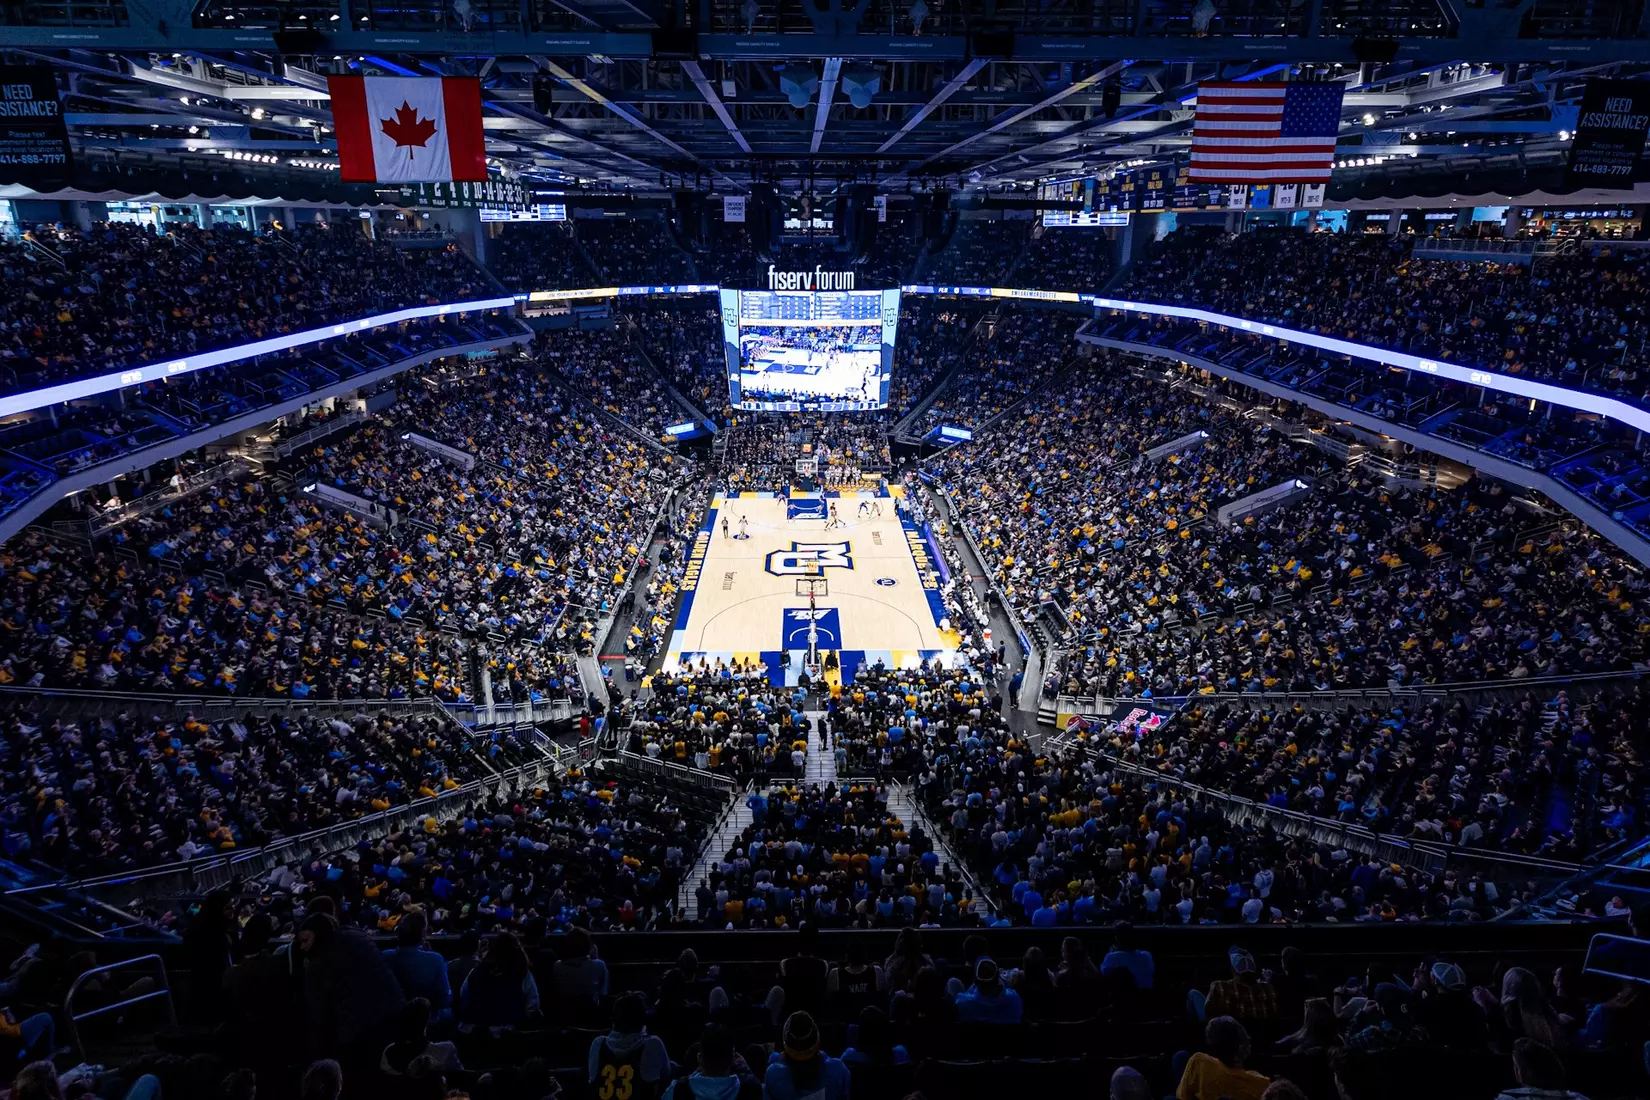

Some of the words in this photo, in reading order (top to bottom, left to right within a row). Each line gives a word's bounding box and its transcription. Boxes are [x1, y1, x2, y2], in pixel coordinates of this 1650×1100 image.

[2, 84, 33, 100] NEED
[1604, 97, 1633, 113] NEED
[1580, 112, 1649, 129] ASSISTANCE?
[690, 530, 710, 558] GOLDEN
[680, 560, 703, 591] EAGLES
[598, 1063, 635, 1100] 33
